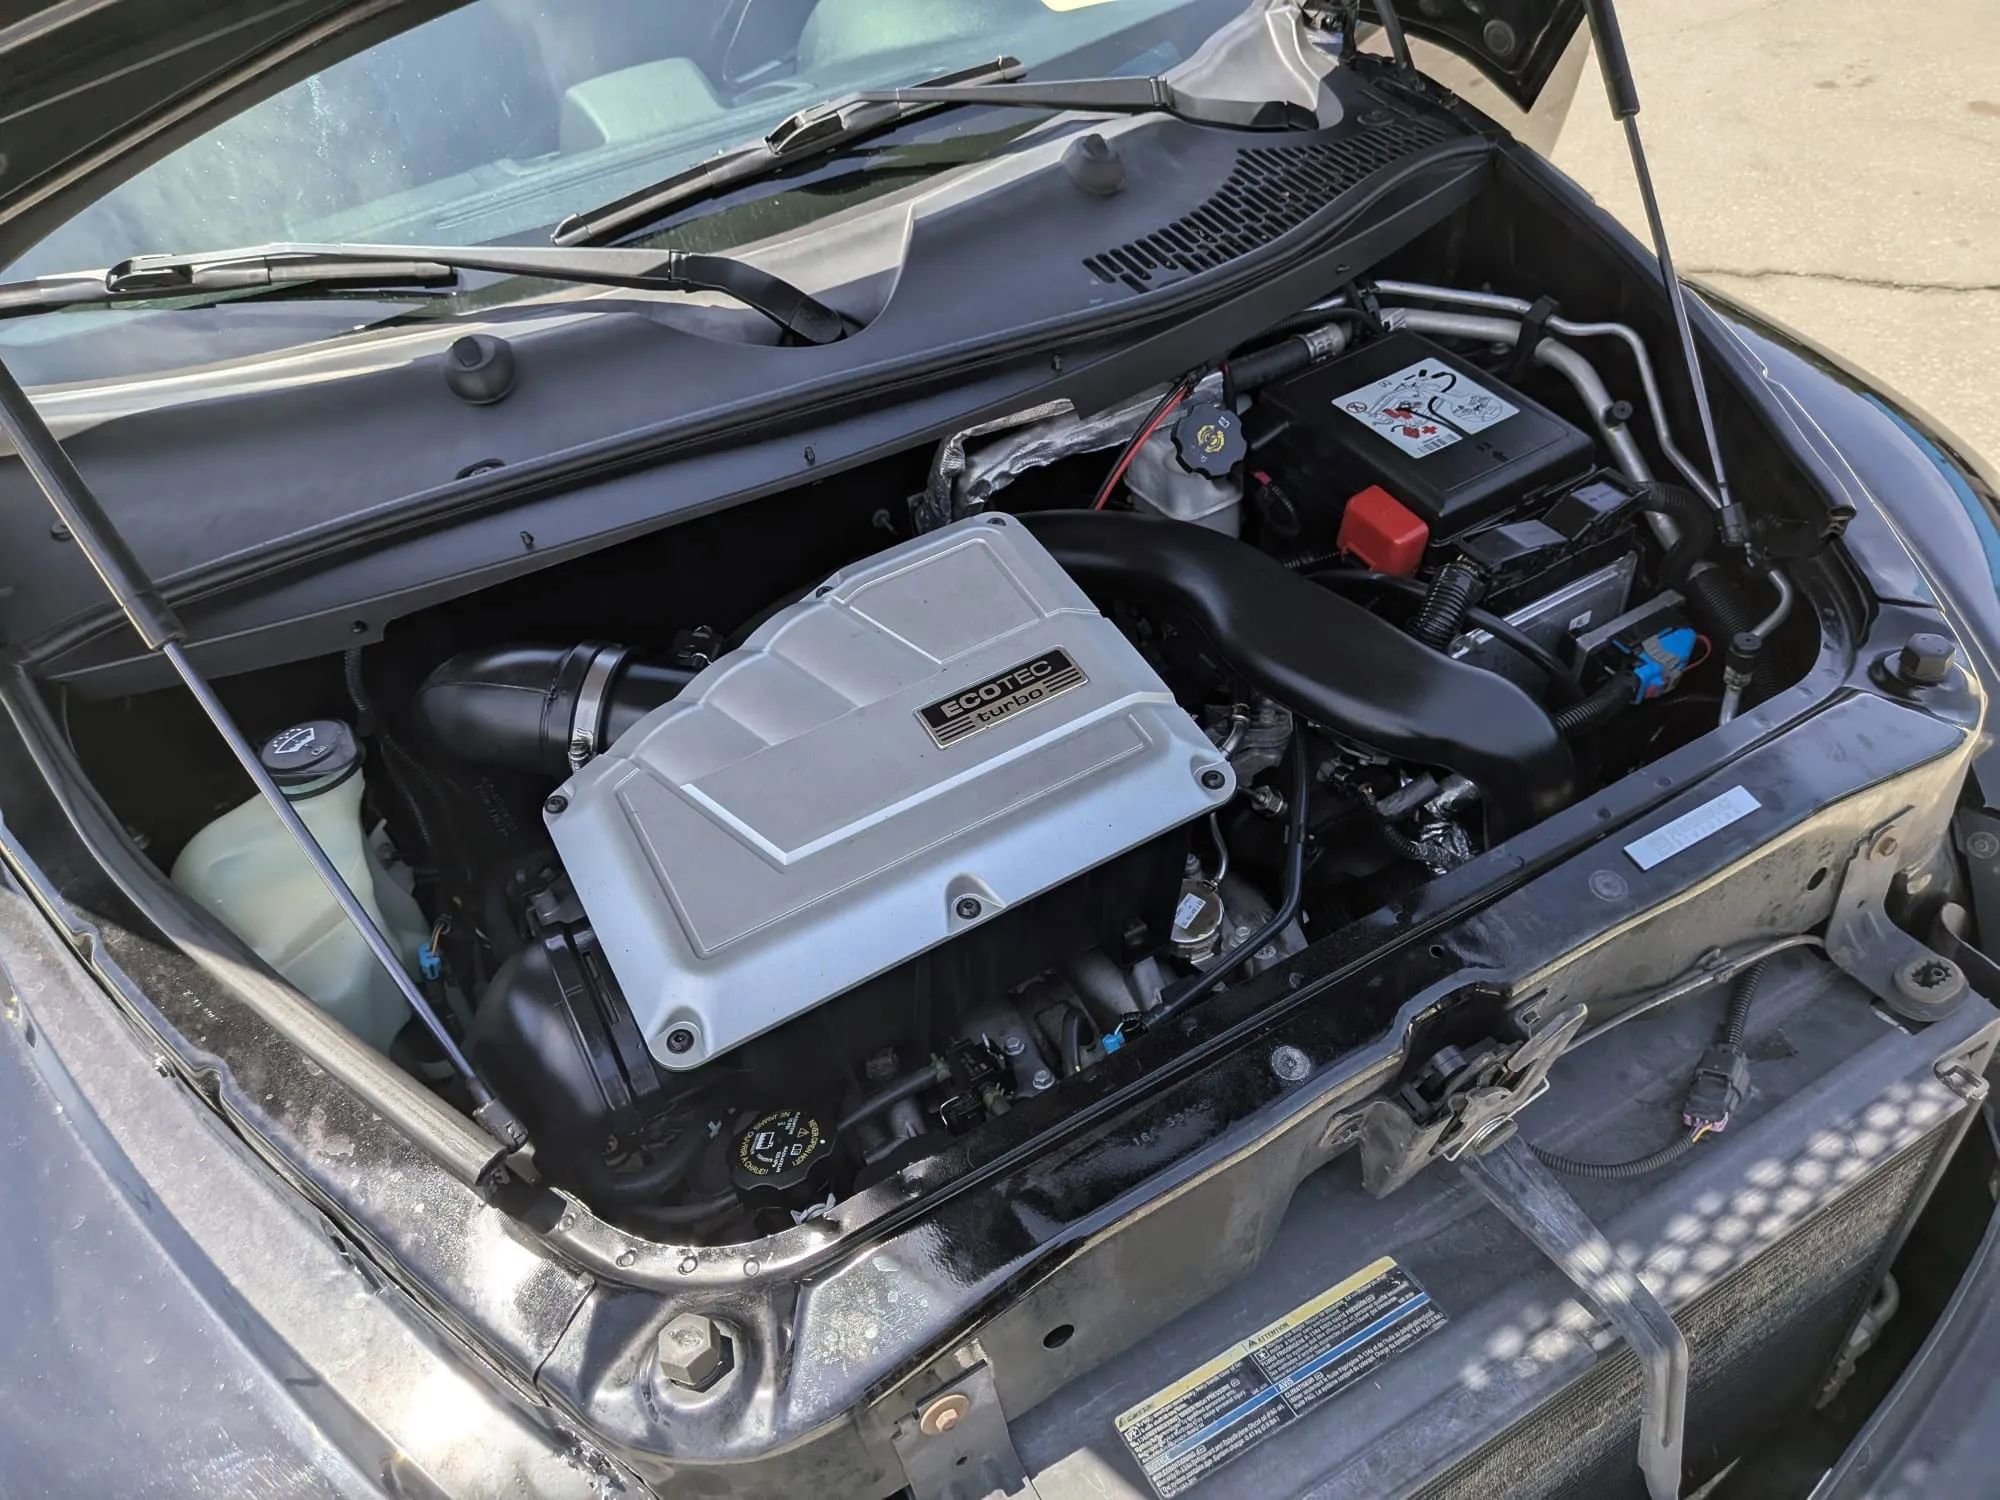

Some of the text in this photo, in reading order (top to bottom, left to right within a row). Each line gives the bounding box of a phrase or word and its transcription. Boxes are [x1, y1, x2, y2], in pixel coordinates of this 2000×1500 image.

[940, 660, 1053, 718] ECOTEC
[976, 687, 1044, 722] turbo
[808, 1119, 818, 1136] NEVER
[804, 1138, 818, 1153] OPEN
[1256, 1321, 1290, 1343] ATTENTION
[1277, 1376, 1294, 1390] AVIS
